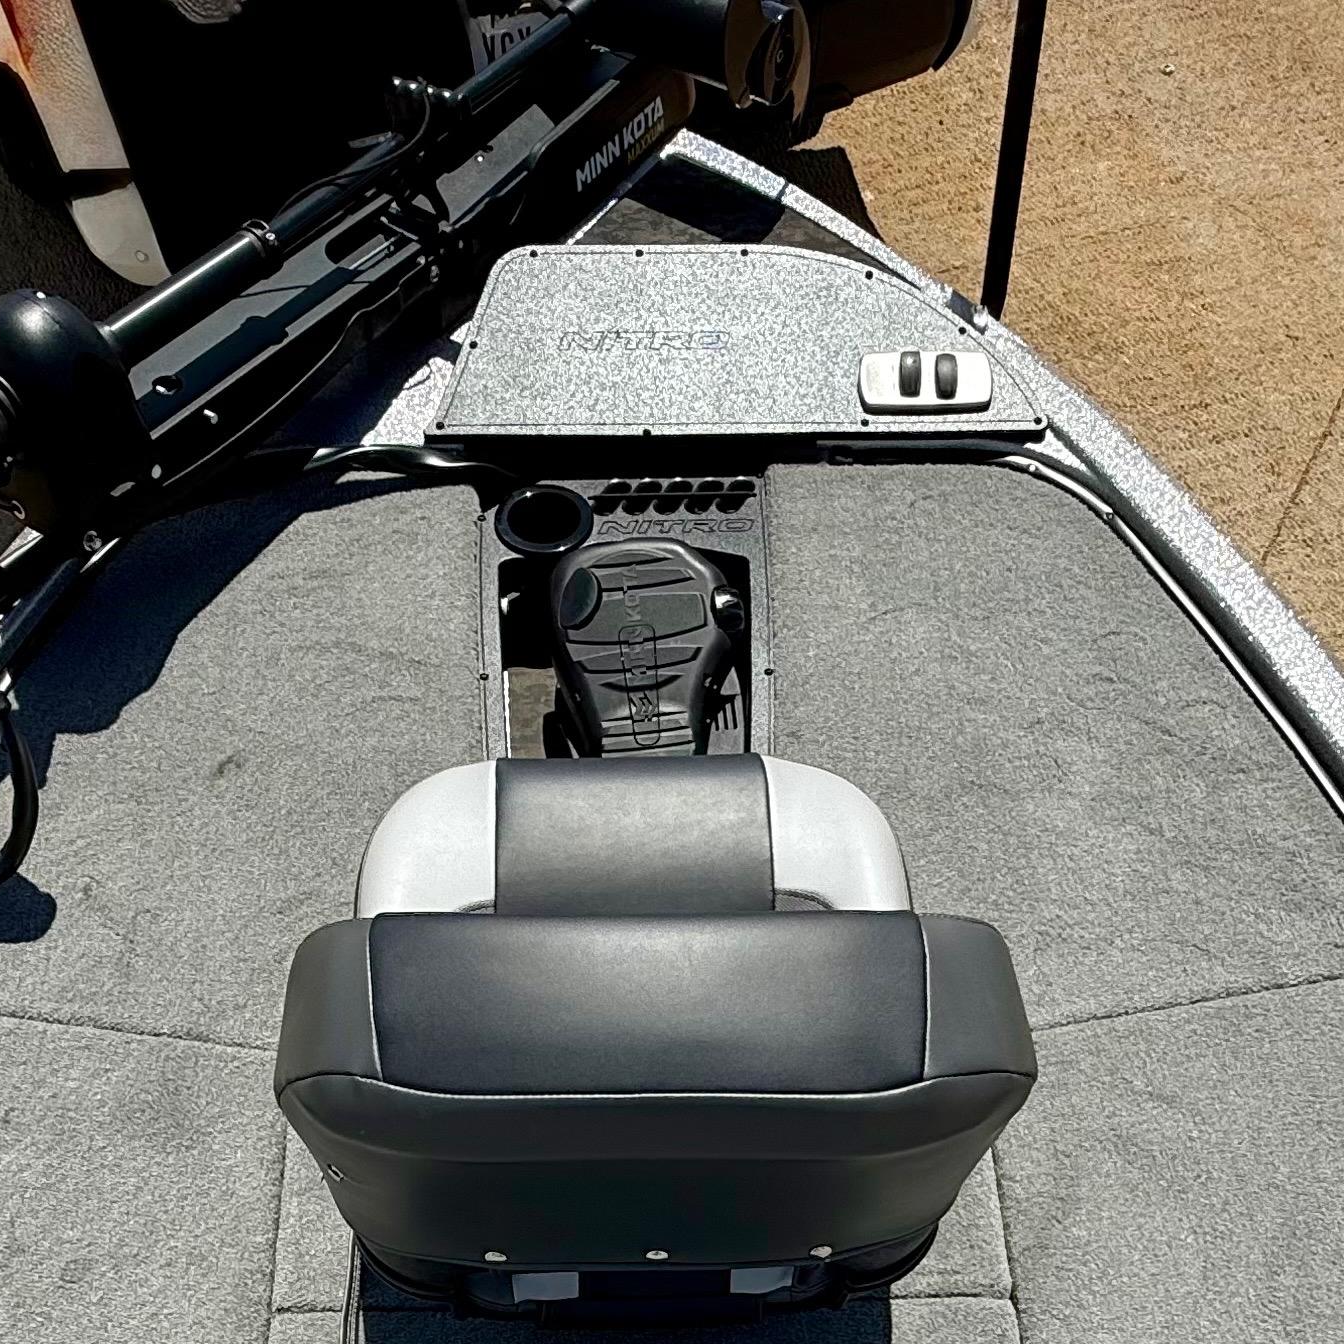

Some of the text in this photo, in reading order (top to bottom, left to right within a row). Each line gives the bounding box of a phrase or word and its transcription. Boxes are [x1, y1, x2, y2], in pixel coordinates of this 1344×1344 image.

[576, 95, 664, 193] MINN KOTA
[558, 331, 731, 351] NITRO
[599, 519, 755, 535] NITRO
[623, 565, 642, 622] KOTA
